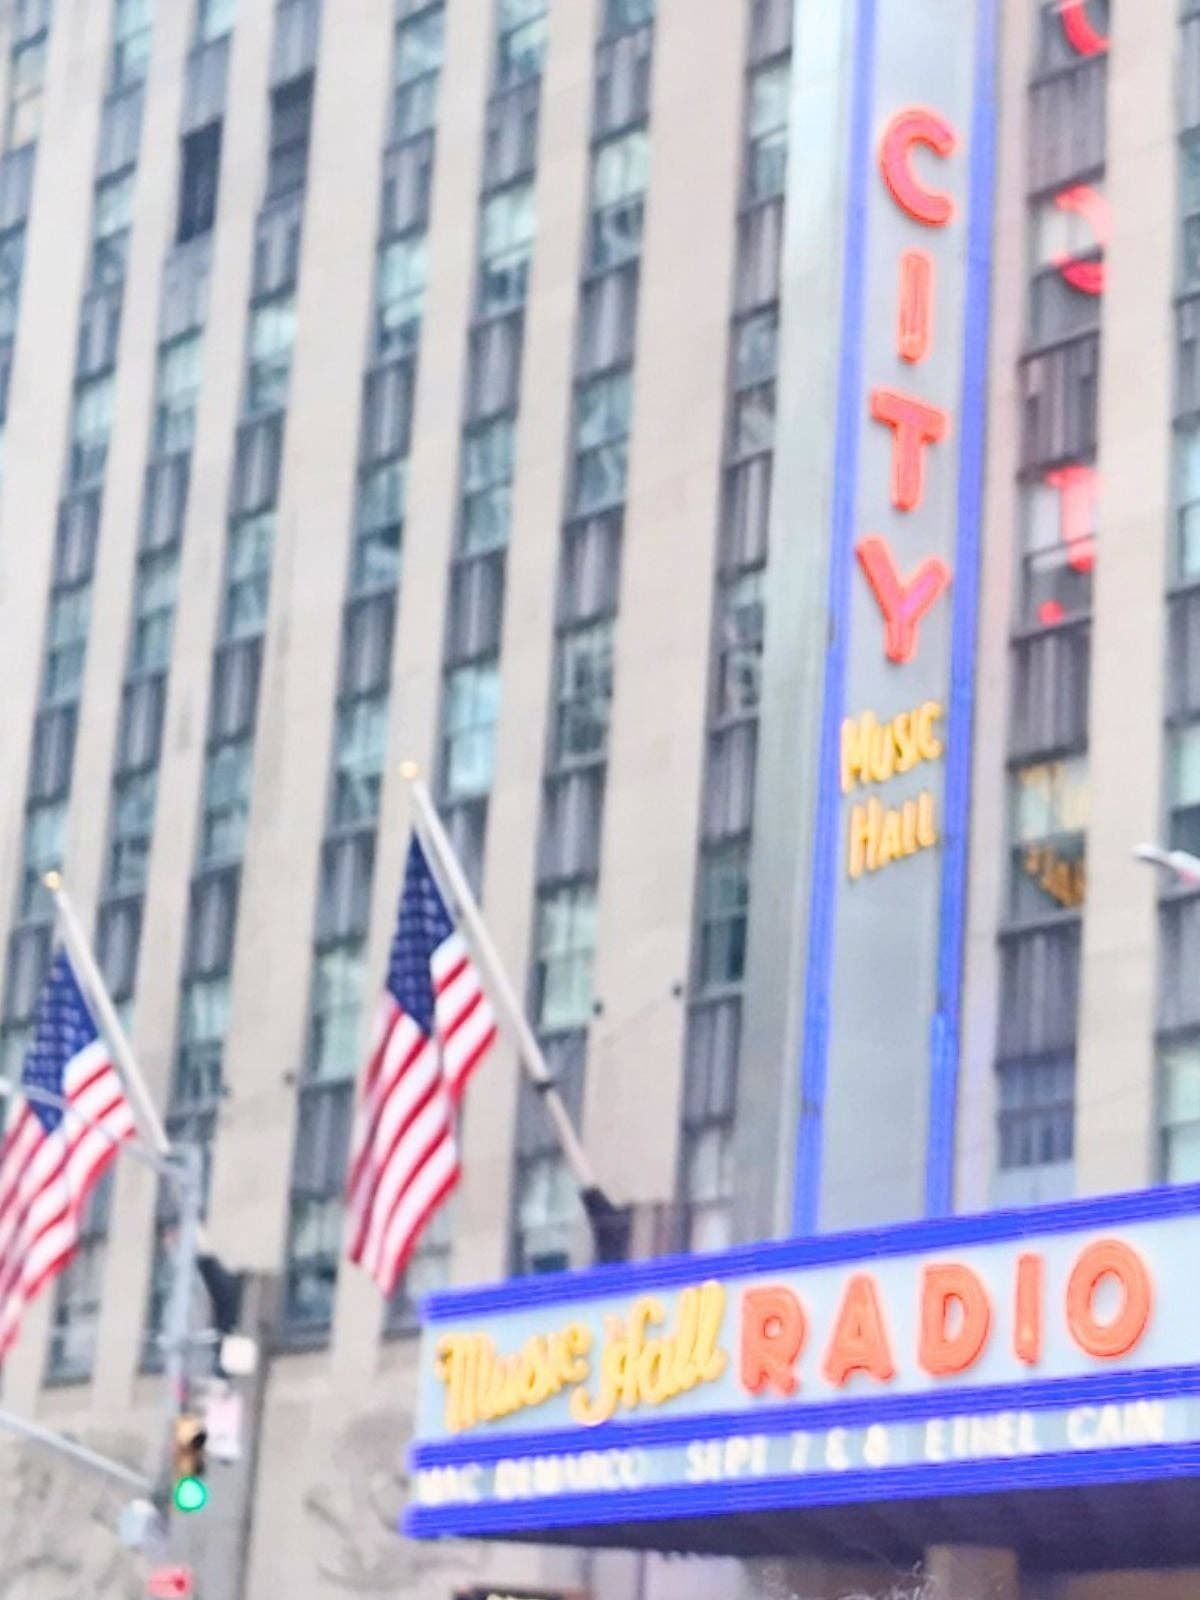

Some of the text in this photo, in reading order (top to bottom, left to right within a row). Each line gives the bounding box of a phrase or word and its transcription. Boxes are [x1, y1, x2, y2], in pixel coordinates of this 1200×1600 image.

[855, 107, 956, 664] CITY
[435, 1323, 590, 1433] Music
[570, 1280, 728, 1425] Hall
[738, 1238, 1154, 1397] RADIO
